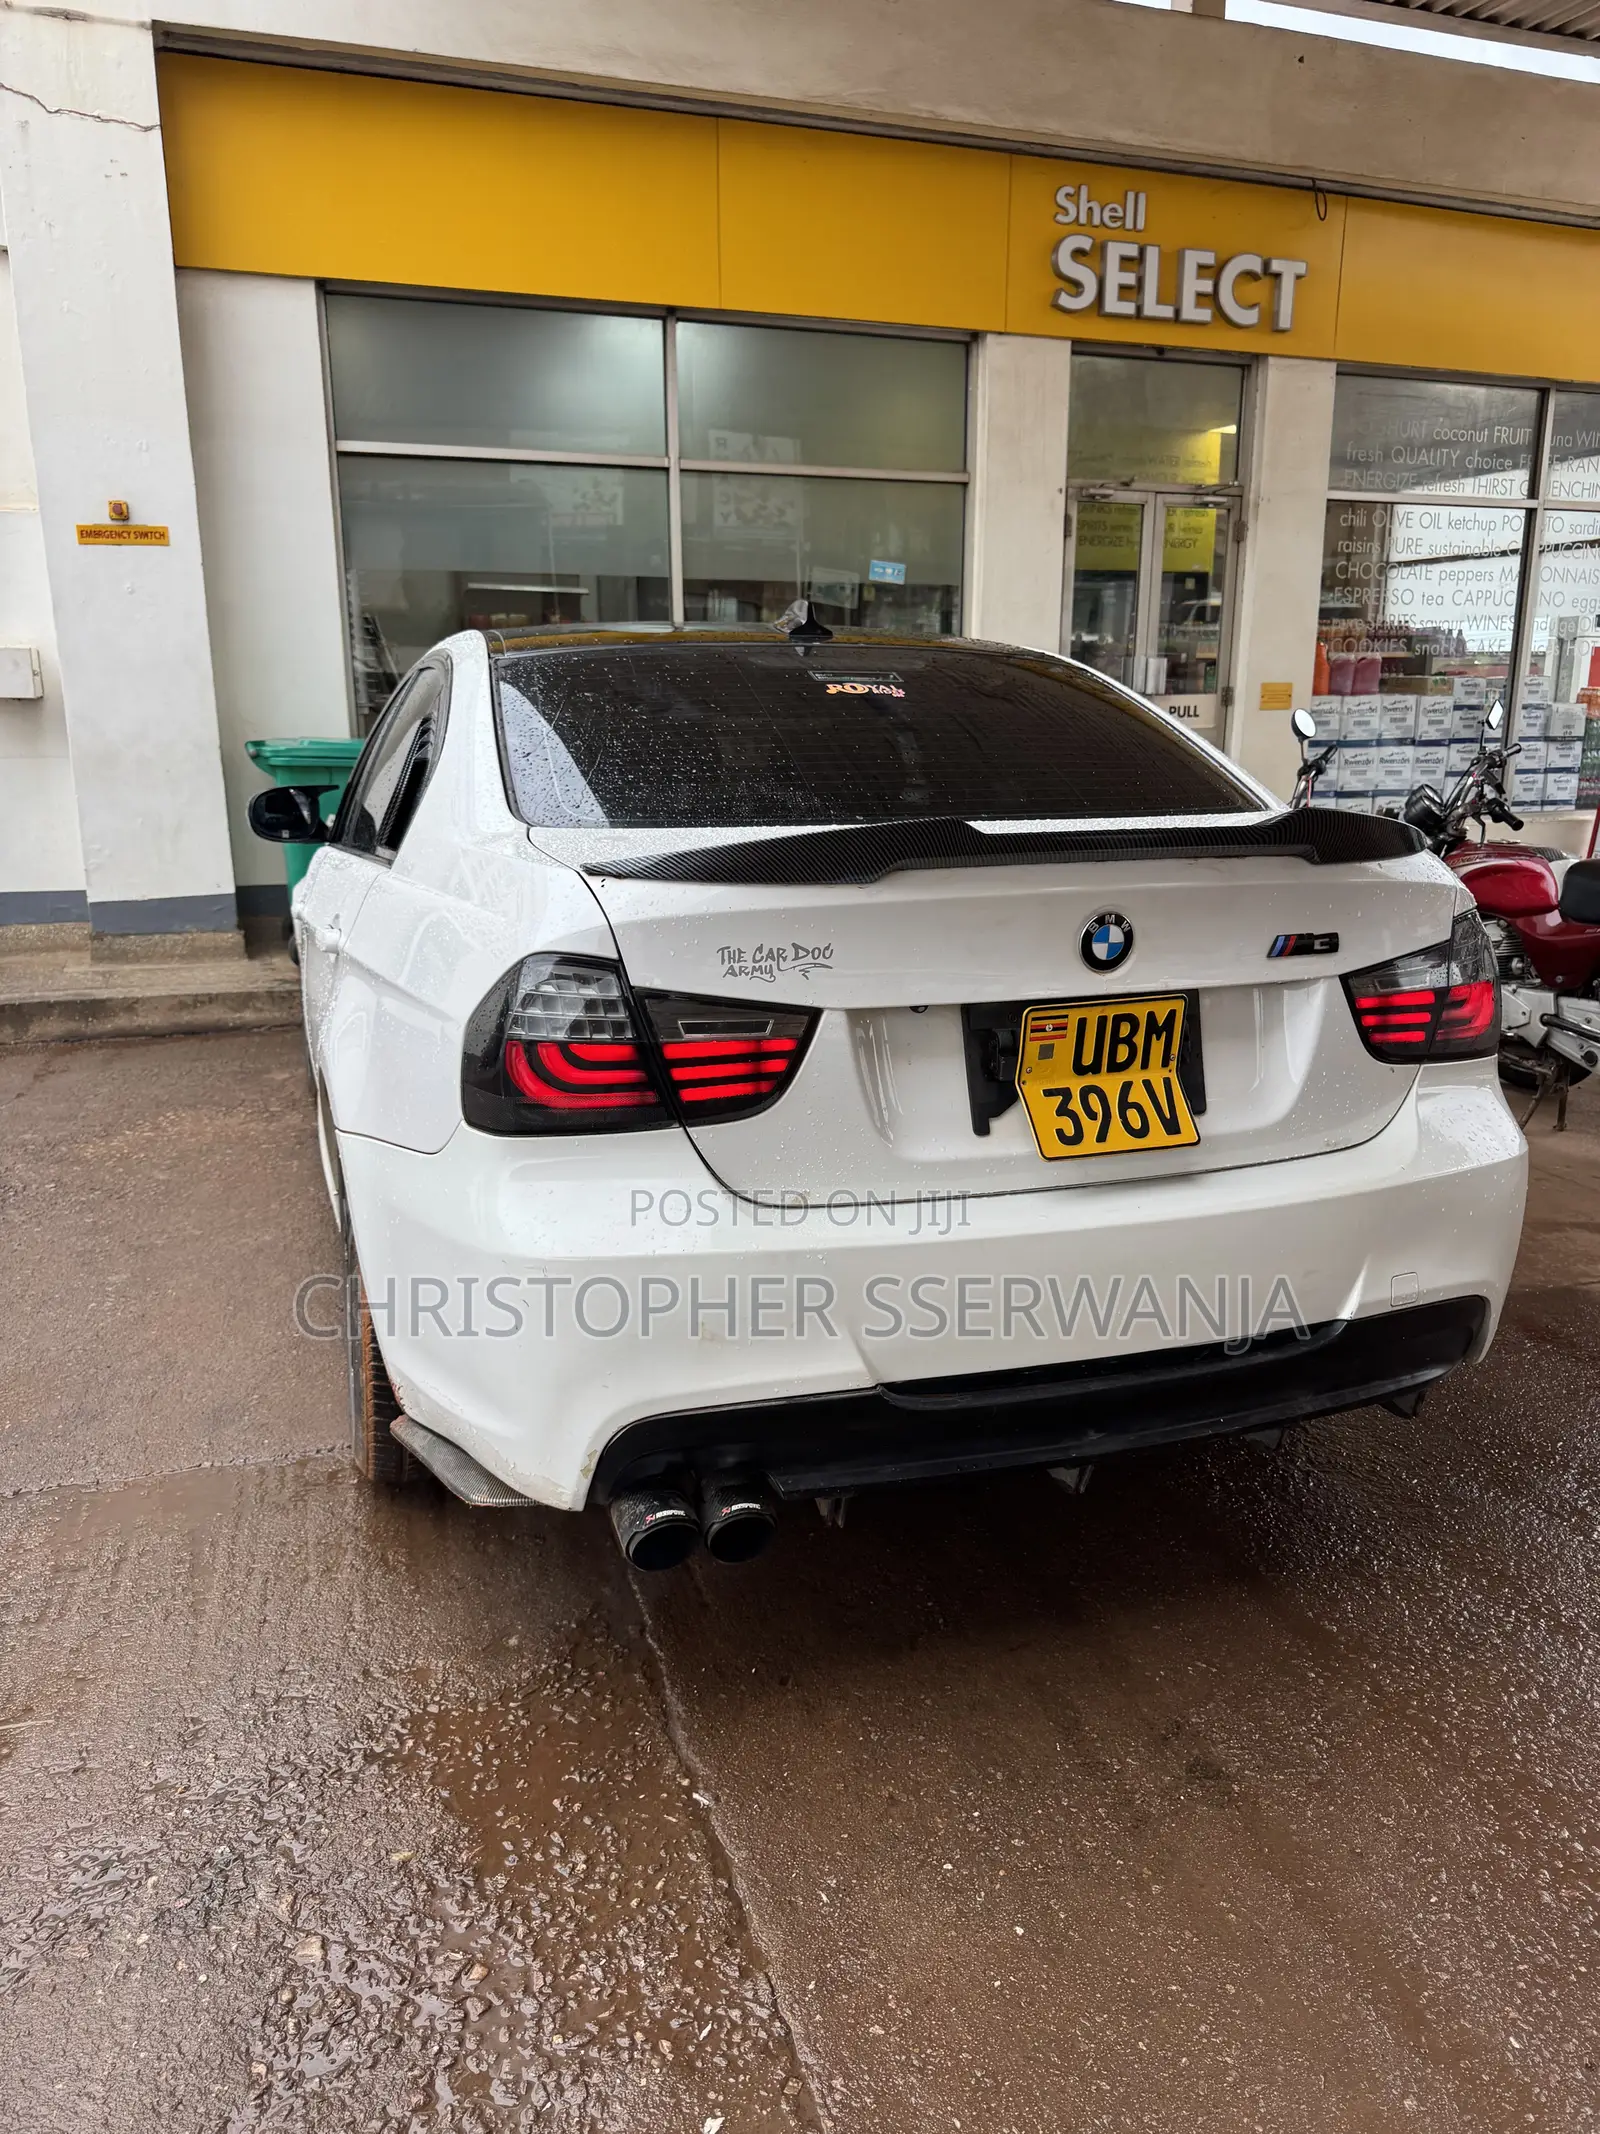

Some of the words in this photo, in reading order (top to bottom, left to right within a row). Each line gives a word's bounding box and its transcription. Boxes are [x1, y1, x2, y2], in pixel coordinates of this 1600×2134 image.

[1054, 184, 1147, 232] Shell
[1051, 233, 1307, 332] SELECT
[1433, 427, 1489, 443] coconut
[1493, 426, 1532, 445] FRUIT
[1346, 441, 1384, 462] fresh
[1391, 446, 1460, 467] QUALITY
[1465, 450, 1512, 470] choice
[1344, 468, 1418, 490] ENERGIZE
[1421, 473, 1465, 493] refresh
[1472, 477, 1516, 496] THIRST
[1340, 507, 1367, 527] chili
[1372, 510, 1414, 529] OLVE
[1419, 512, 1442, 529] OIL
[1447, 511, 1497, 536] ketchup
[1337, 536, 1381, 553] raisins
[1388, 537, 1424, 555] PURE
[1428, 539, 1501, 557] sustainable
[1335, 561, 1433, 581] CHOCOLATE
[1438, 568, 1494, 587] peppers
[1421, 591, 1444, 606] tea
[1452, 589, 1566, 608] CAPPUCNO
[1467, 614, 1514, 632] WINES
[1331, 636, 1408, 655] COOKIES
[1415, 637, 1456, 656] snack
[1465, 638, 1506, 656] CAKE
[1169, 704, 1199, 718] PULL
[1088, 914, 1131, 934] BMW
[716, 945, 748, 966] THE
[752, 943, 788, 971] CAR
[722, 964, 776, 982] ARMY
[1072, 1009, 1177, 1077] UBM
[1042, 1077, 1182, 1146] 396V
